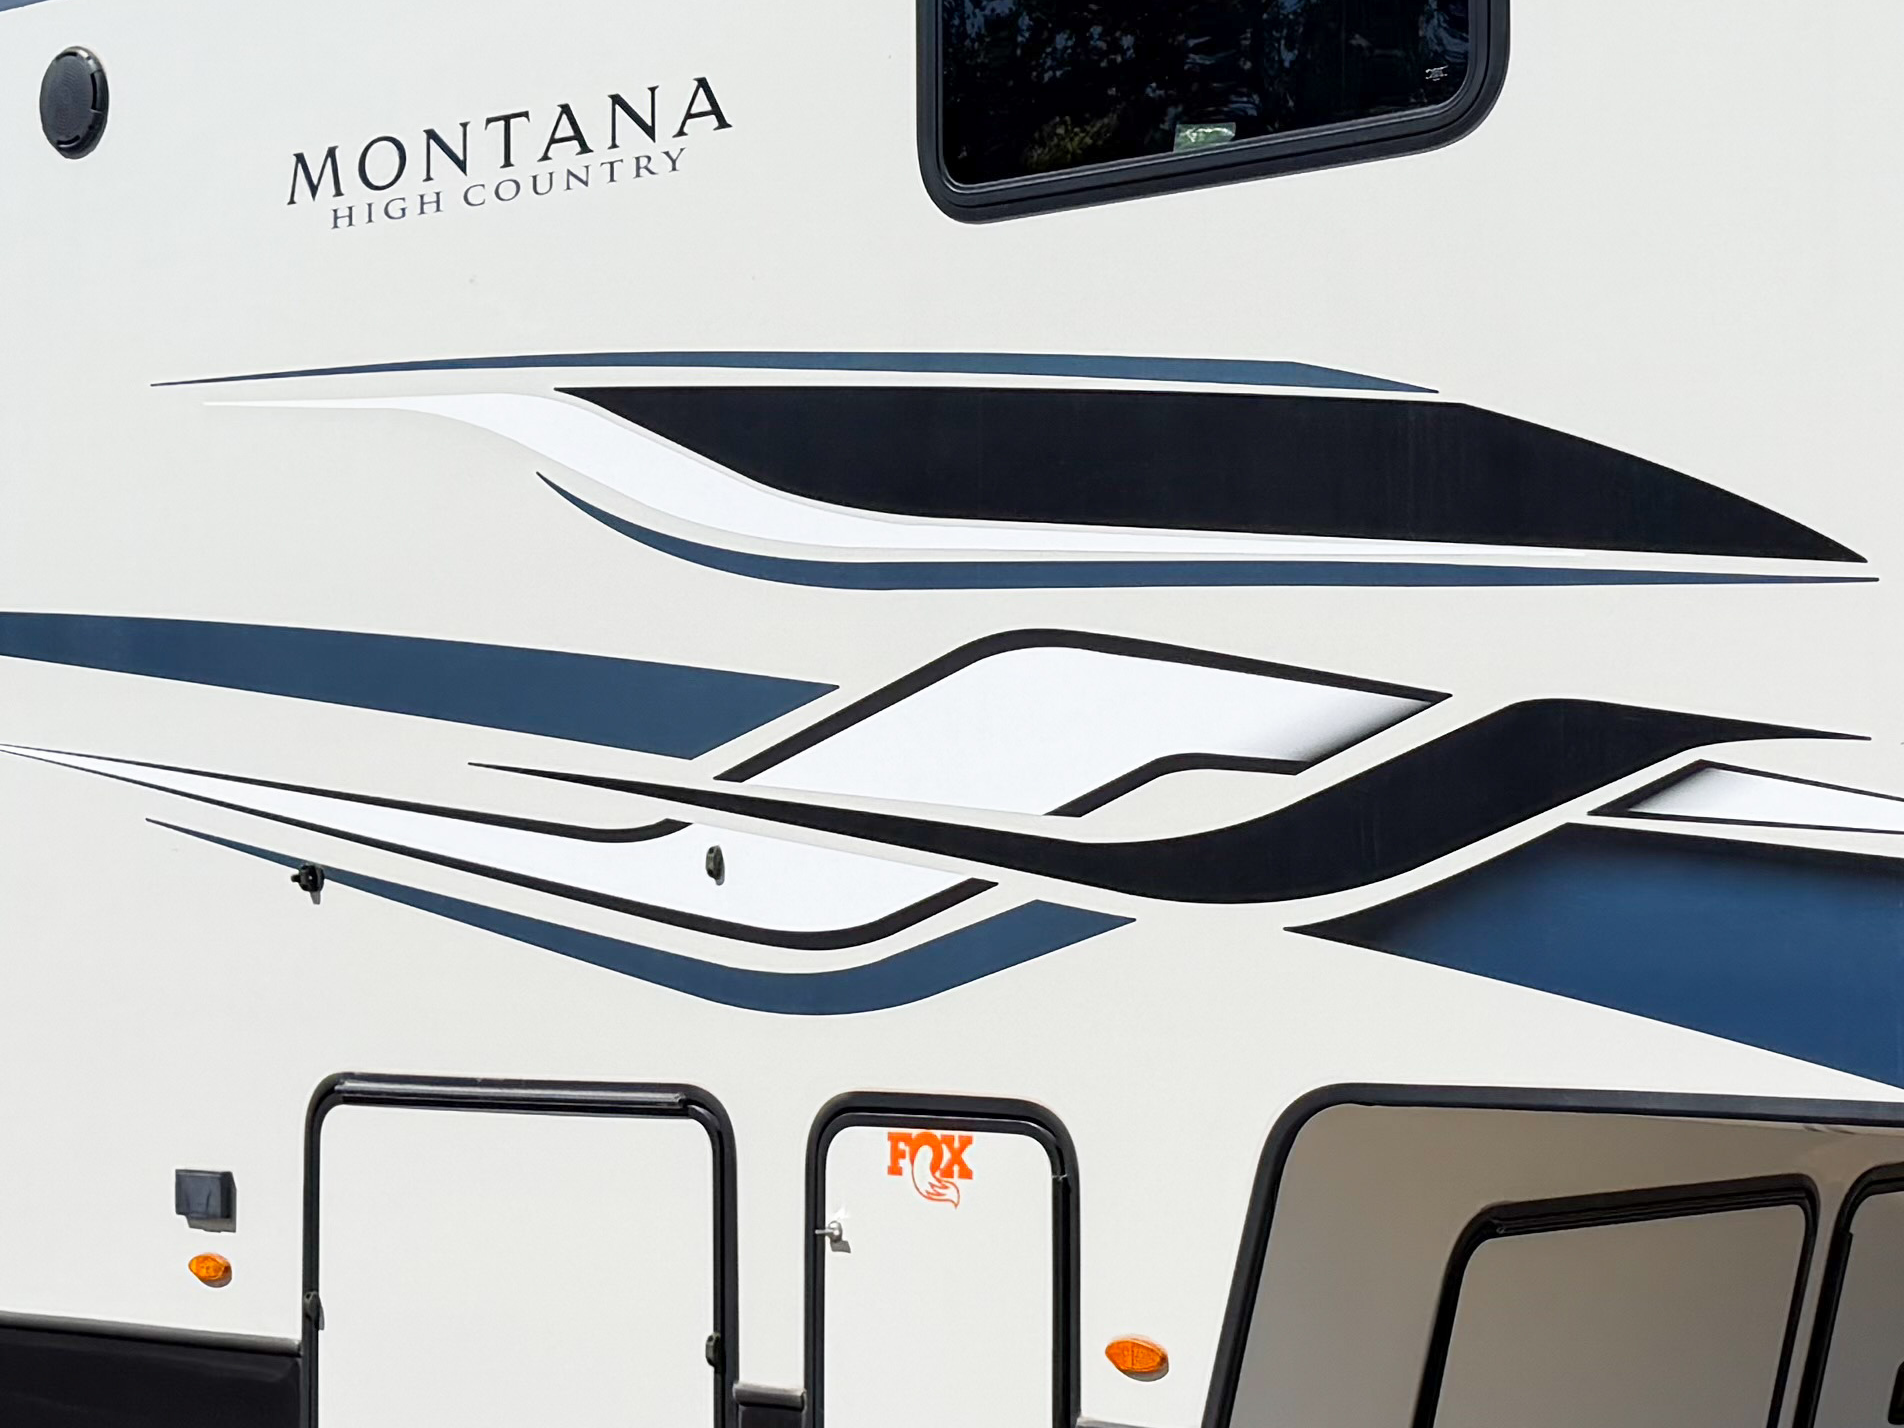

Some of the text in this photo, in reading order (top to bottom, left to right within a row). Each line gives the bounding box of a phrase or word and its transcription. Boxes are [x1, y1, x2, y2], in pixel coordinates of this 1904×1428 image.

[286, 76, 733, 205] MONTANA
[330, 146, 688, 230] HIGH COUNTRY
[887, 1131, 974, 1209] FOX
